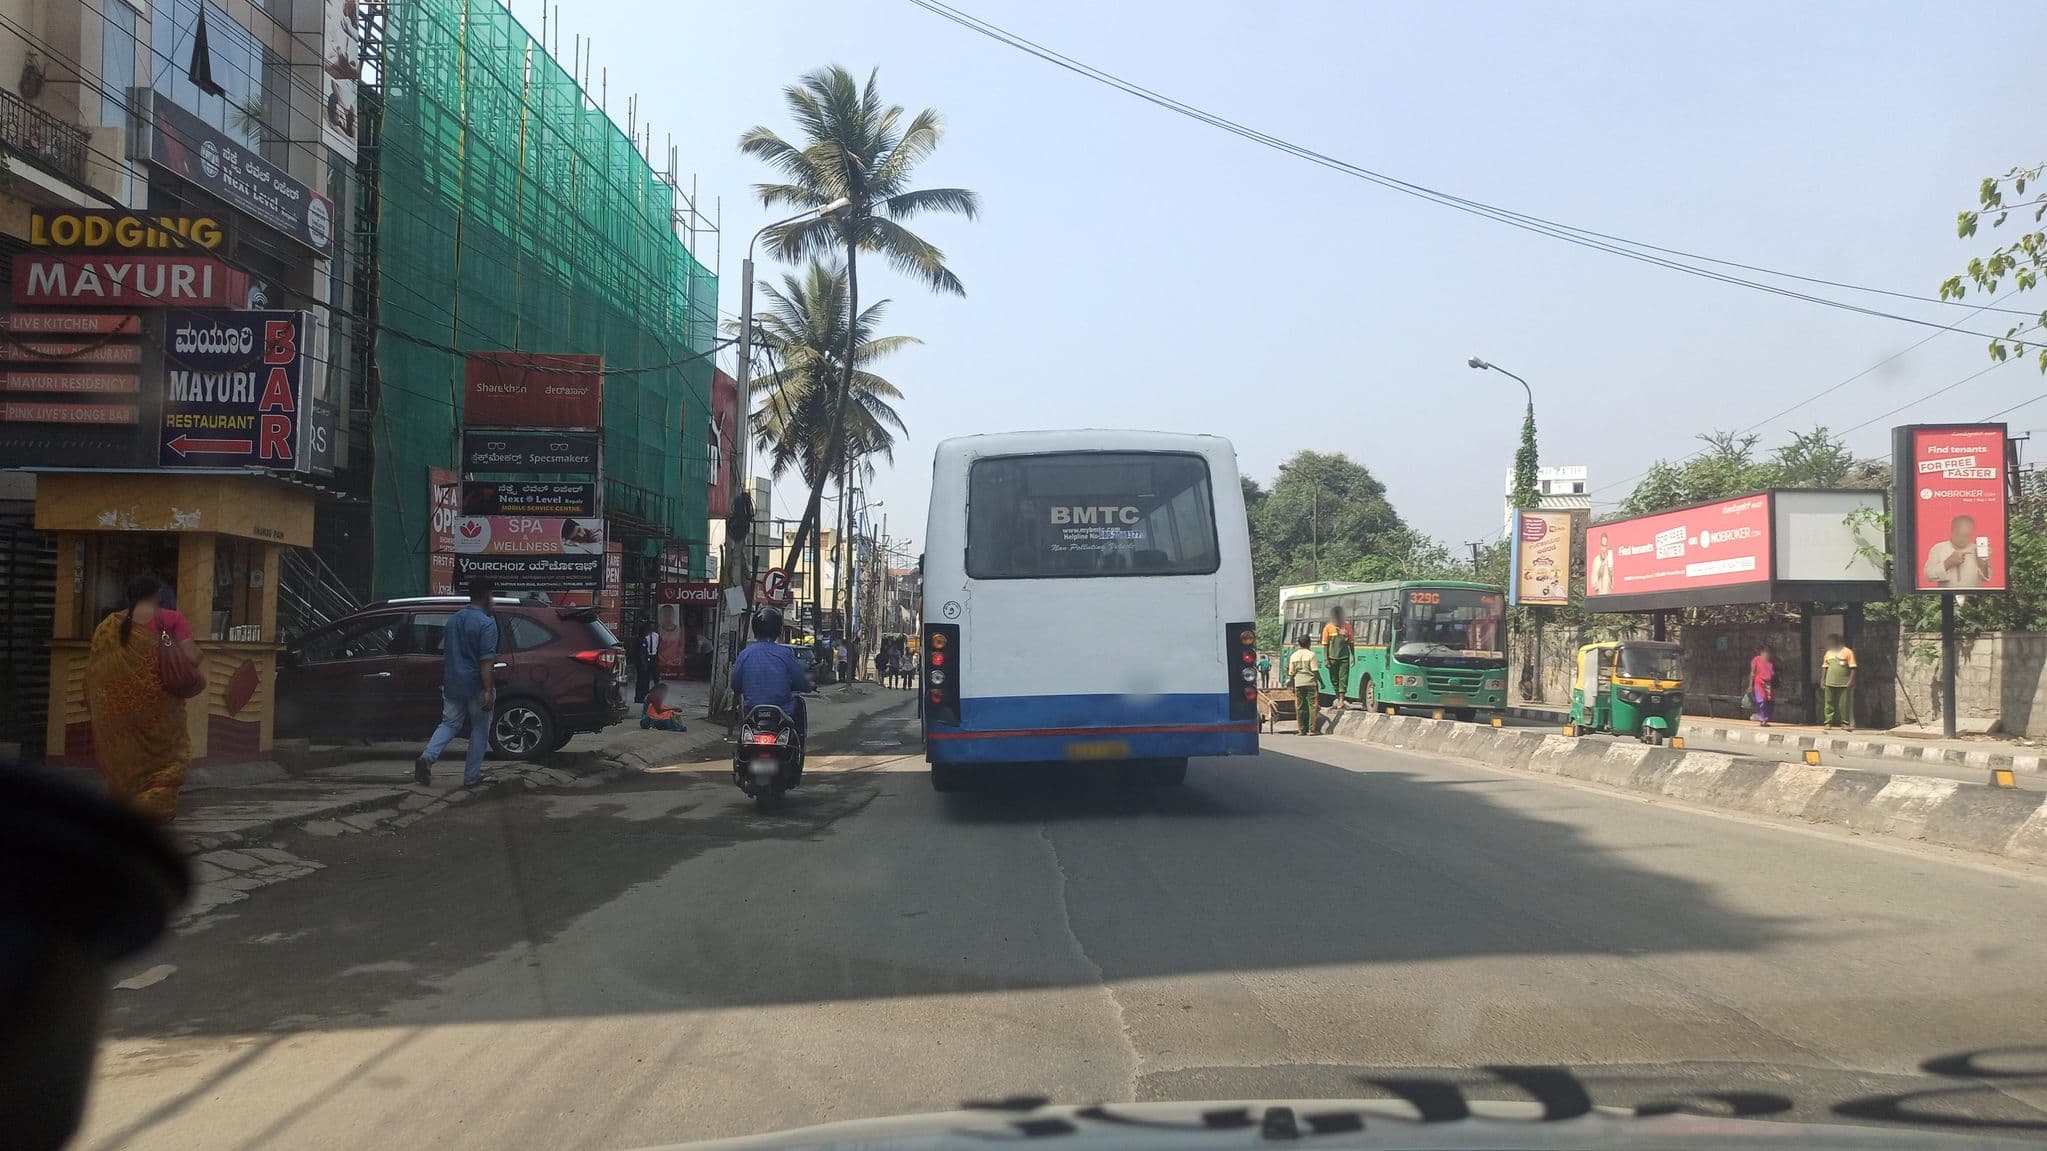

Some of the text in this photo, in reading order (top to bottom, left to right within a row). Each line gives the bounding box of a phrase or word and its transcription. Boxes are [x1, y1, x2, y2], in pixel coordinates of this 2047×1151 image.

[31, 214, 223, 249] LODGING
[27, 261, 213, 299] MAYURI
[13, 318, 99, 330] LIVE KITCHEN
[175, 321, 254, 355] ಮಯೂರಿ
[11, 377, 128, 389] MAYURI RESIDENCY
[169, 370, 256, 403] MAYURI
[476, 382, 528, 394] Sharekhan
[258, 320, 297, 460] BAR
[166, 414, 255, 430] RESTAURANT
[1928, 446, 1987, 454] Find tenants
[529, 453, 590, 465] Specsmakers
[1920, 458, 1973, 472] FOR FREE
[499, 494, 525, 504] Next
[536, 496, 563, 504] Level
[1050, 506, 1140, 524] BMTC
[508, 520, 543, 533] SPA
[493, 541, 558, 552] WELLNESS
[1410, 592, 1440, 604] 329G
